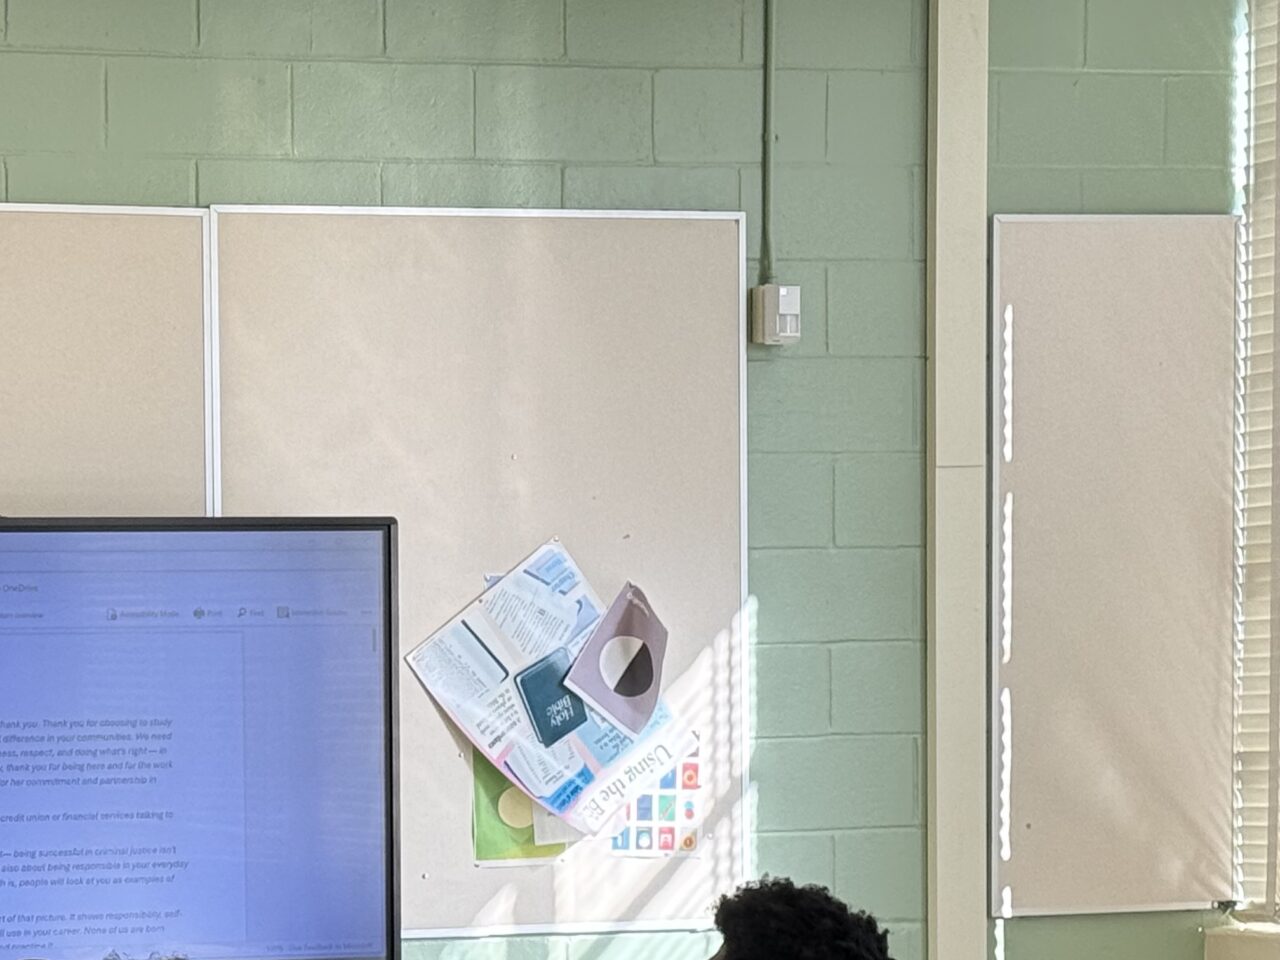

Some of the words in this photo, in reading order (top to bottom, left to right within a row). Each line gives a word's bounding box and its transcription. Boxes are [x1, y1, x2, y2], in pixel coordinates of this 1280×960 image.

[2, 584, 38, 592] OneDrive
[546, 694, 572, 716] Bible
[551, 706, 574, 727] Holy
[624, 745, 672, 782] Using
[600, 778, 626, 802] the
